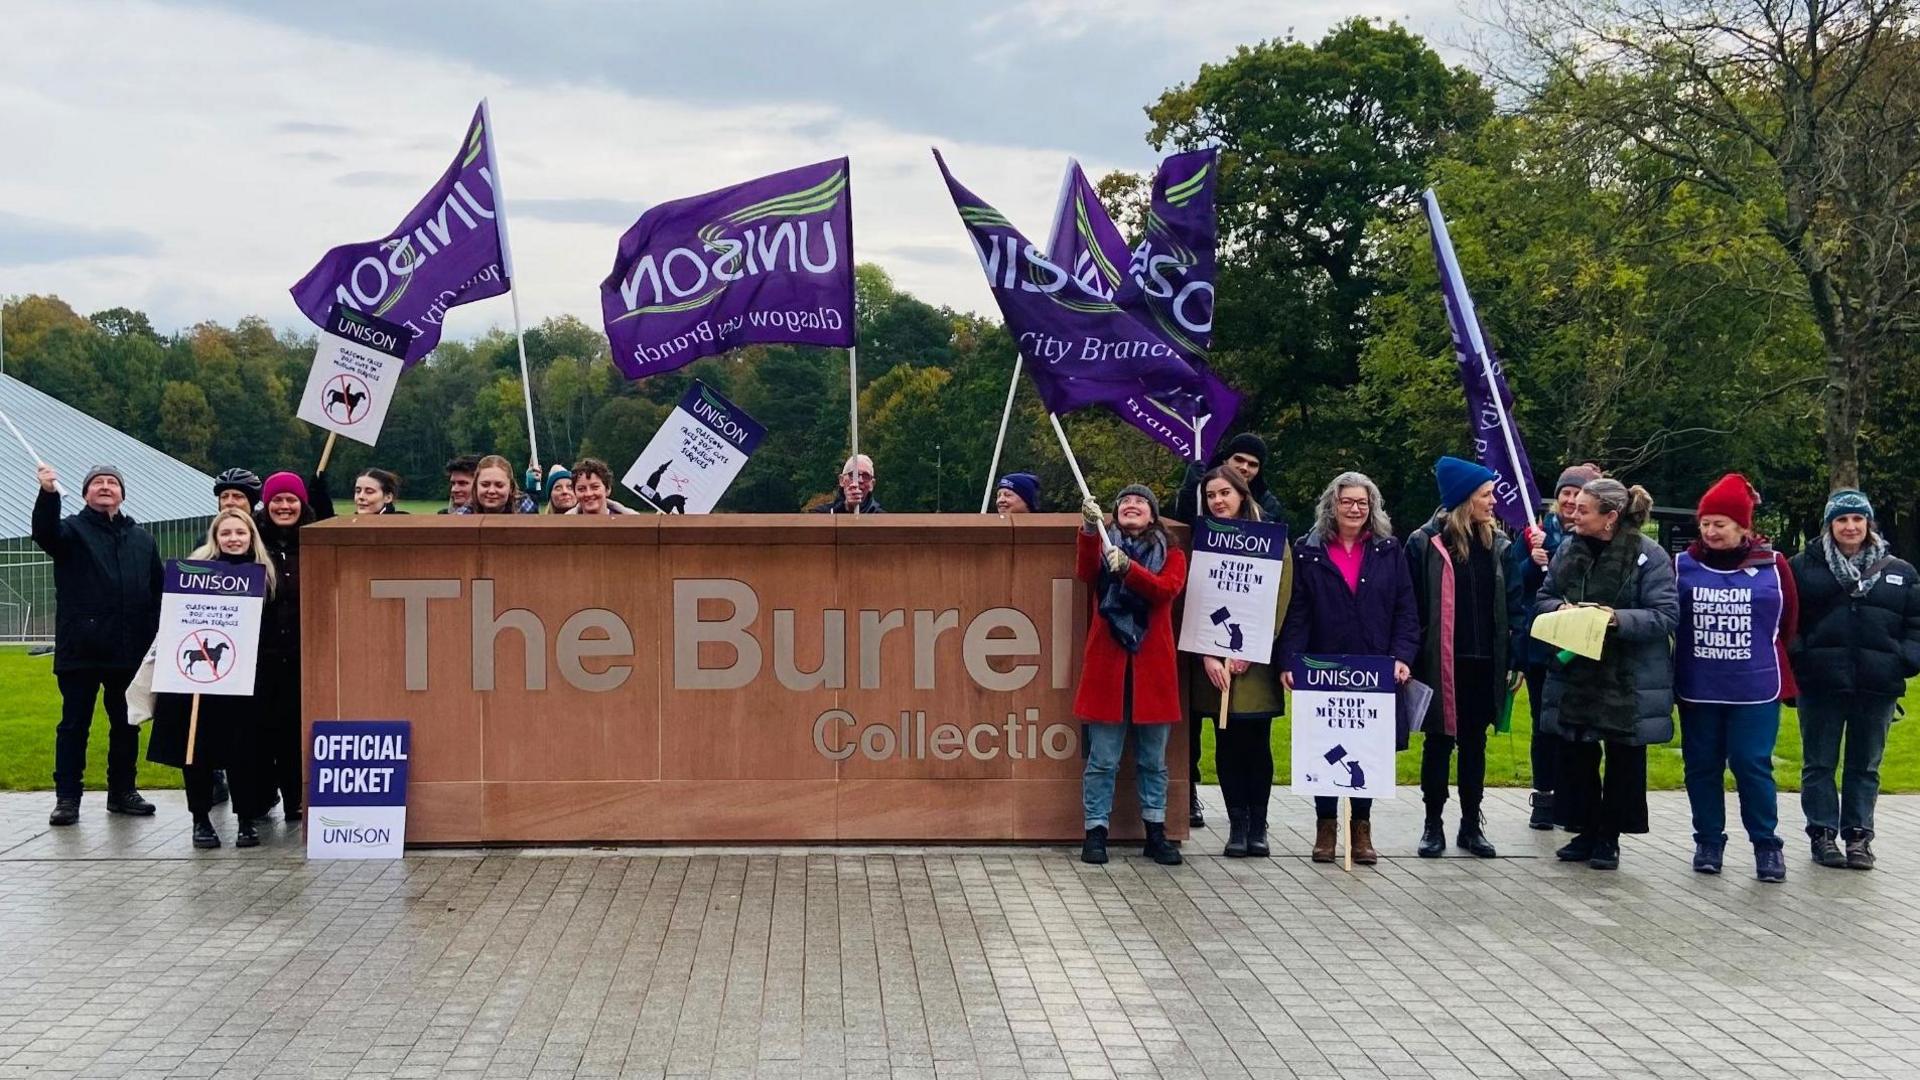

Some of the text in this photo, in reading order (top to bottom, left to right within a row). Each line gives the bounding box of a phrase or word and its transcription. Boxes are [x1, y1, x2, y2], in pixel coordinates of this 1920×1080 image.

[338, 317, 397, 350] UNISON
[693, 398, 749, 444] UNISON
[1126, 397, 1192, 457] Branch
[1207, 531, 1272, 553] UNISON
[1220, 560, 1254, 573] STOP
[179, 573, 250, 592] UNISON
[1208, 569, 1263, 585] MUSEUM
[1217, 581, 1250, 594] CUTS
[1692, 586, 1752, 602] UNISON
[1692, 602, 1752, 615] SPEAKING
[1692, 614, 1752, 631] UP FOR
[369, 577, 1073, 692] The Burrel
[1693, 630, 1752, 648] PUBLIC
[1693, 646, 1752, 660] SERVICES
[1307, 669, 1379, 687] UNISON
[1328, 696, 1365, 708] STOP
[1315, 706, 1378, 719] MUSEUM
[1328, 718, 1365, 730] CUTS
[813, 707, 1080, 761] Collectio
[313, 734, 408, 761] OFFICIAL
[318, 767, 395, 793] PICKET
[323, 828, 390, 844] UNISON
